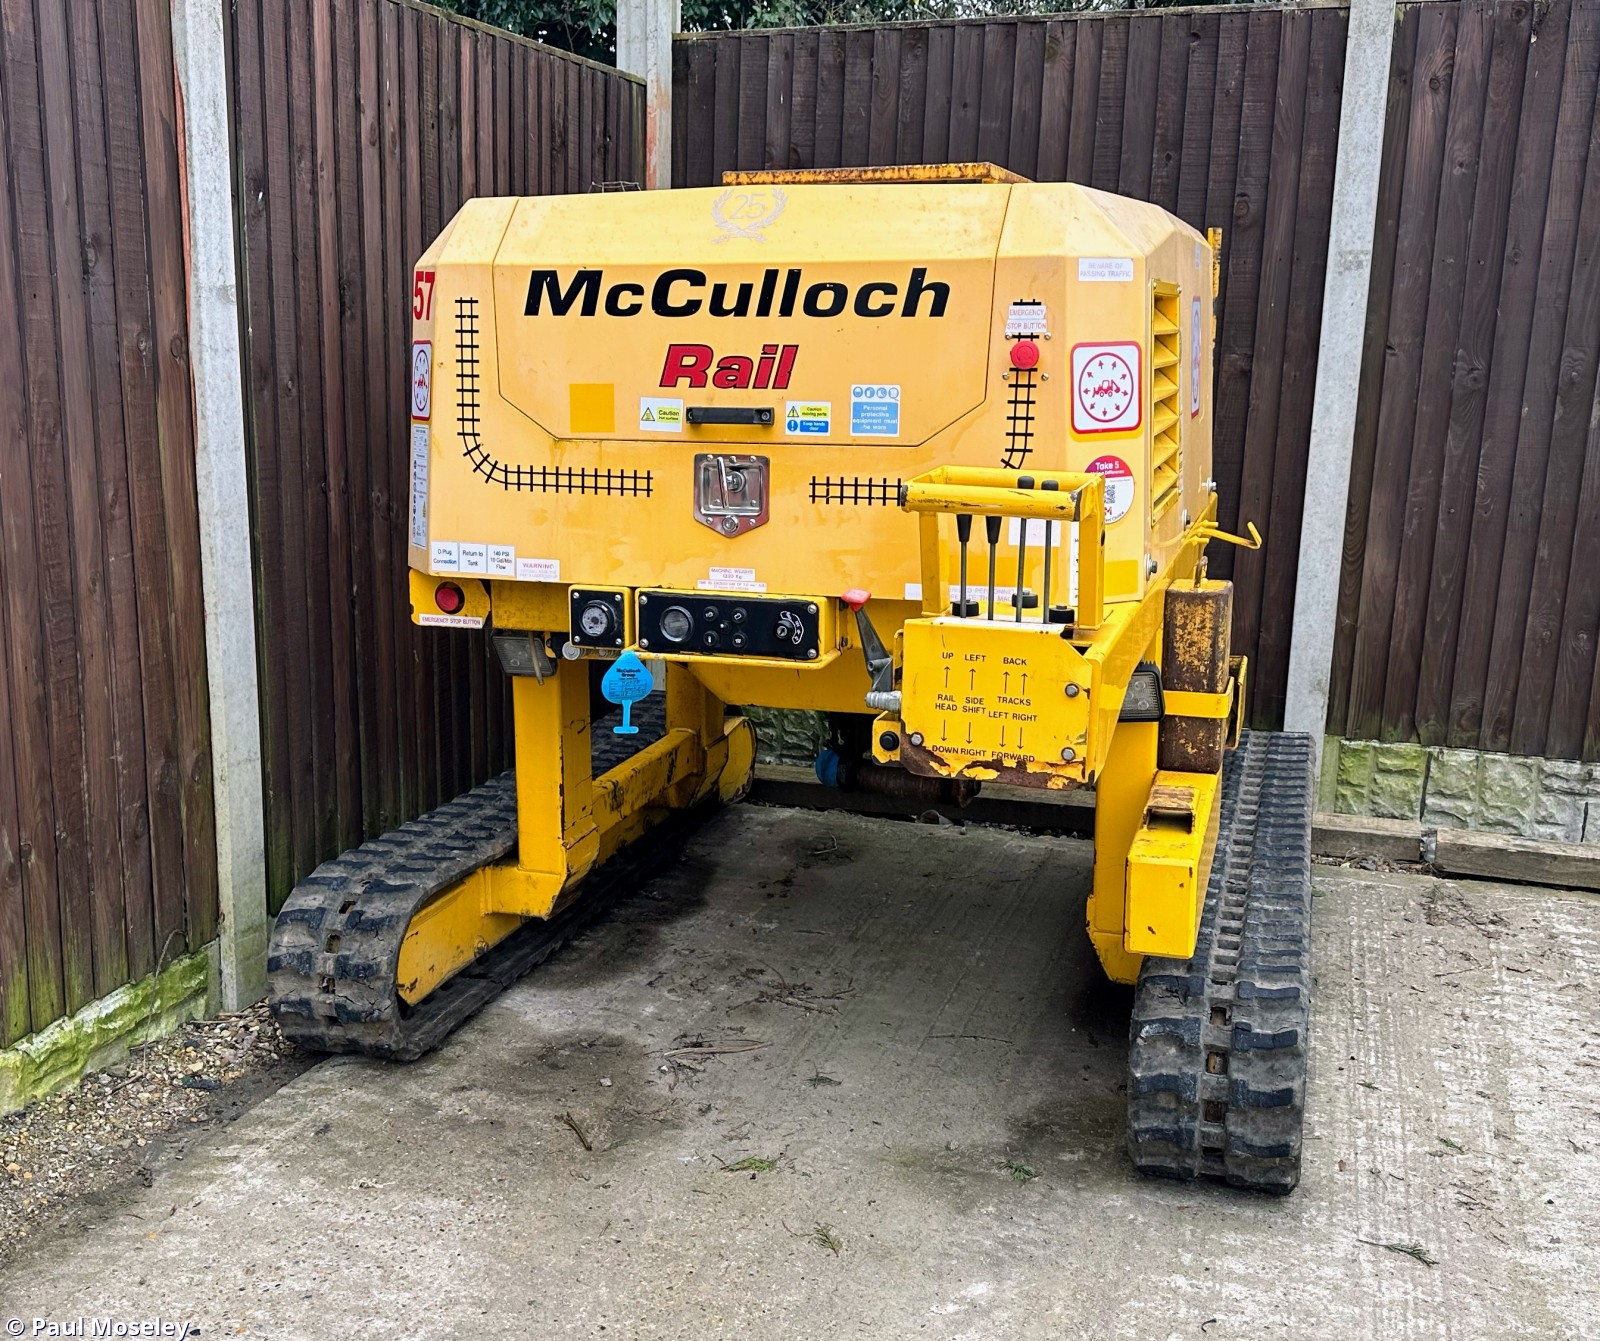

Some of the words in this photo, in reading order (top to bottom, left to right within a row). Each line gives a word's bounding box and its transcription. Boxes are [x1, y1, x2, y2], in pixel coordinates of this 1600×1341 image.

[729, 193, 766, 219] 25
[413, 271, 435, 320] 57
[523, 267, 950, 318] McCulloch
[658, 344, 799, 390] Rail
[1095, 462, 1113, 470] Take
[1115, 461, 1119, 469] 5
[964, 654, 987, 662] LEFT
[1003, 657, 1027, 665] BACK
[937, 694, 956, 702] RAIL
[965, 697, 984, 705] SIDE
[997, 696, 1031, 706] TRACKS
[935, 703, 957, 711] HEAD
[962, 706, 986, 714] SHIFT
[988, 711, 1008, 719] LEFT
[1012, 713, 1038, 722] RIGHT
[932, 745, 959, 754] DOWN
[960, 748, 987, 757] RIGHT
[992, 752, 1035, 763] FORWARD
